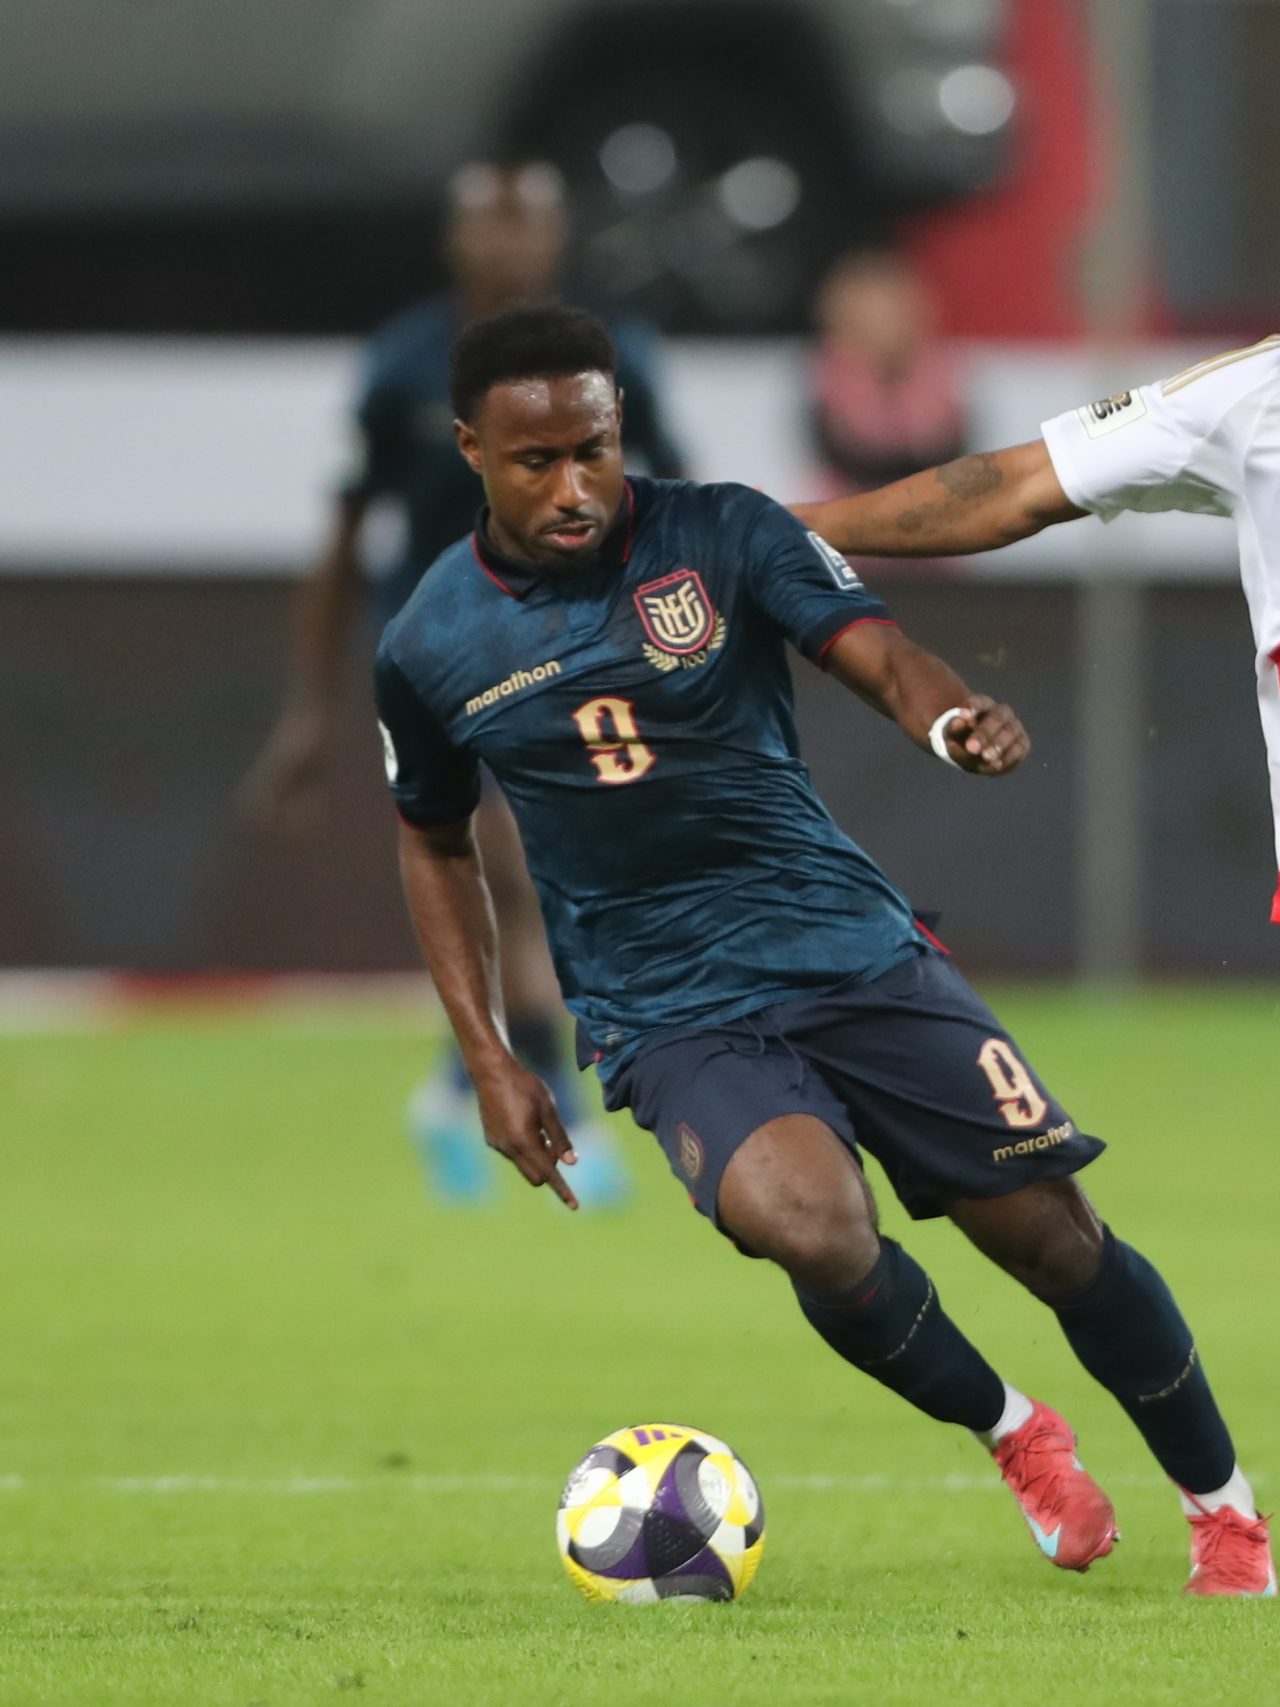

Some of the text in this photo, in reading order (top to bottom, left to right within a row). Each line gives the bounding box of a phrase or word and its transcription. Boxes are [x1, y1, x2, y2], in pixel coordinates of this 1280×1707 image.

[465, 660, 562, 716] marathon
[572, 695, 656, 784] 9
[976, 1037, 1047, 1128] 9
